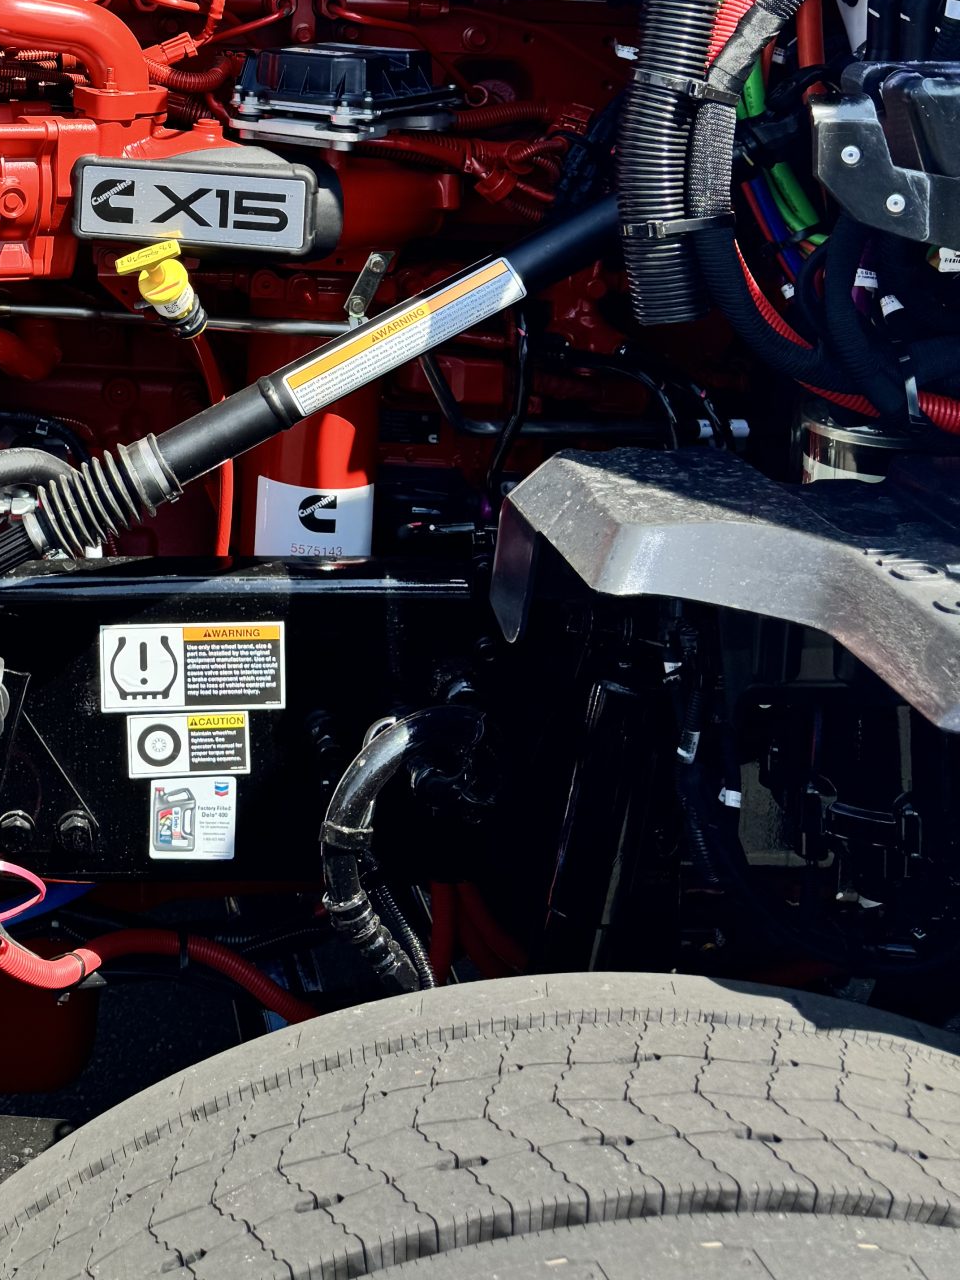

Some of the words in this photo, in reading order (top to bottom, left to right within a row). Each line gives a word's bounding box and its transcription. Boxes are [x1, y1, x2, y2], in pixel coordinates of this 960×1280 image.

[91, 179, 132, 207] Cummins
[150, 184, 289, 232] X15
[377, 308, 425, 337] WARNING
[298, 494, 336, 518] Cummins
[290, 543, 343, 557] 5575143
[211, 628, 260, 637] WARNING
[199, 717, 243, 726] CAUTION
